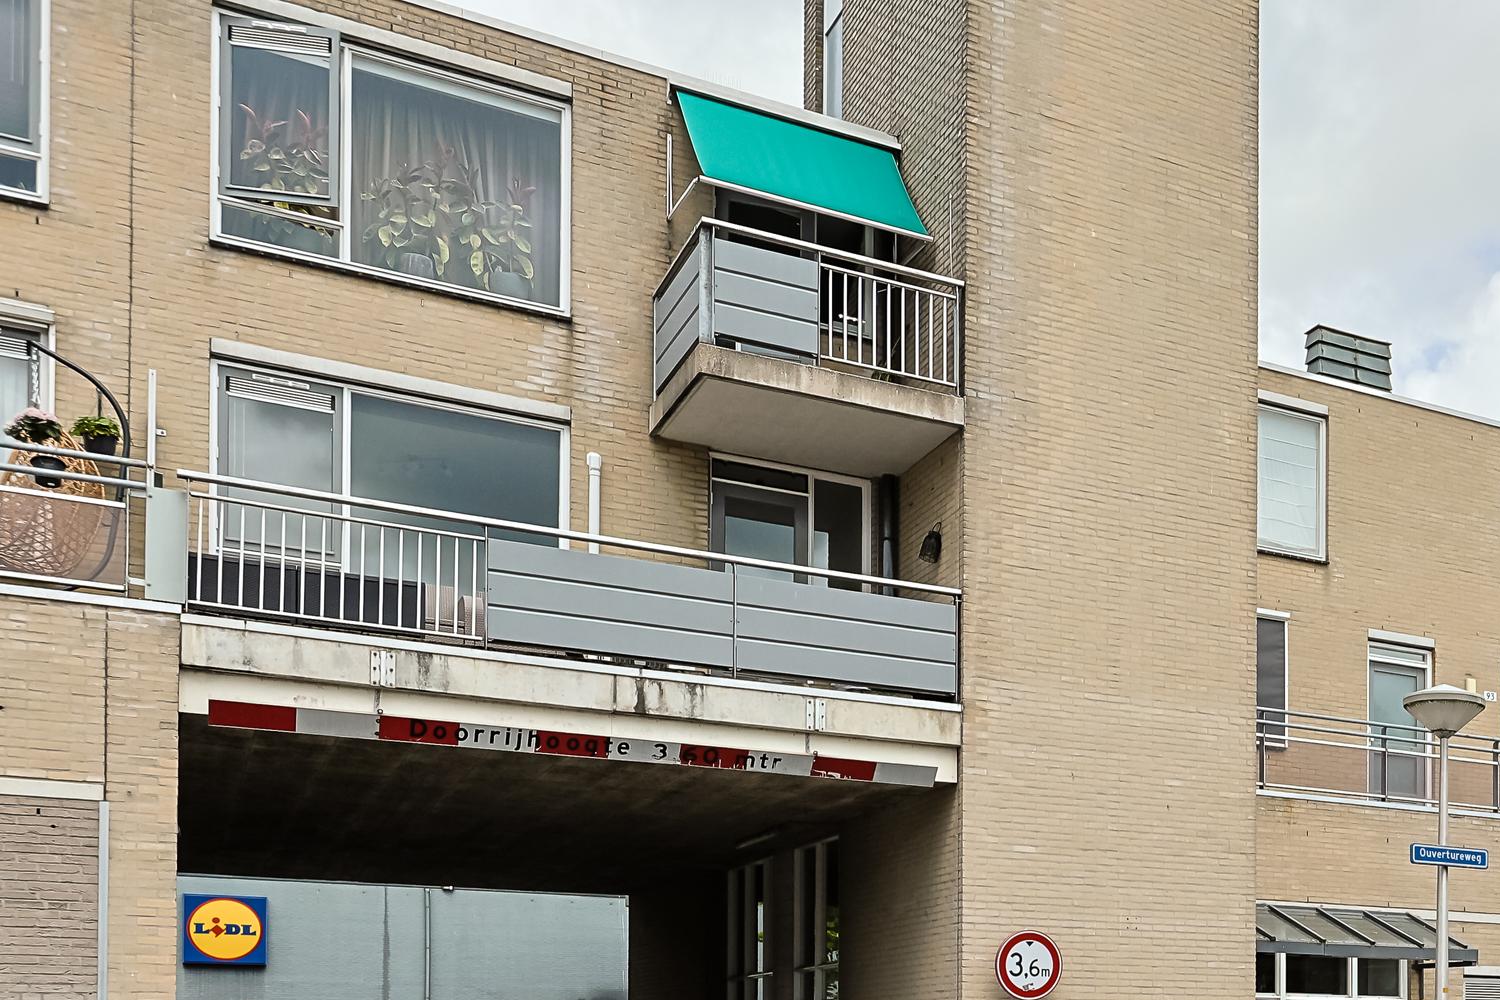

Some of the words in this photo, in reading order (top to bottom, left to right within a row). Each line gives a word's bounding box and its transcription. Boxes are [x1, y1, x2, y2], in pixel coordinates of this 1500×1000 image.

[1486, 692, 1495, 701] 93
[409, 719, 630, 757] Doorrijhoogte
[1419, 847, 1482, 864] Ouvertureweg
